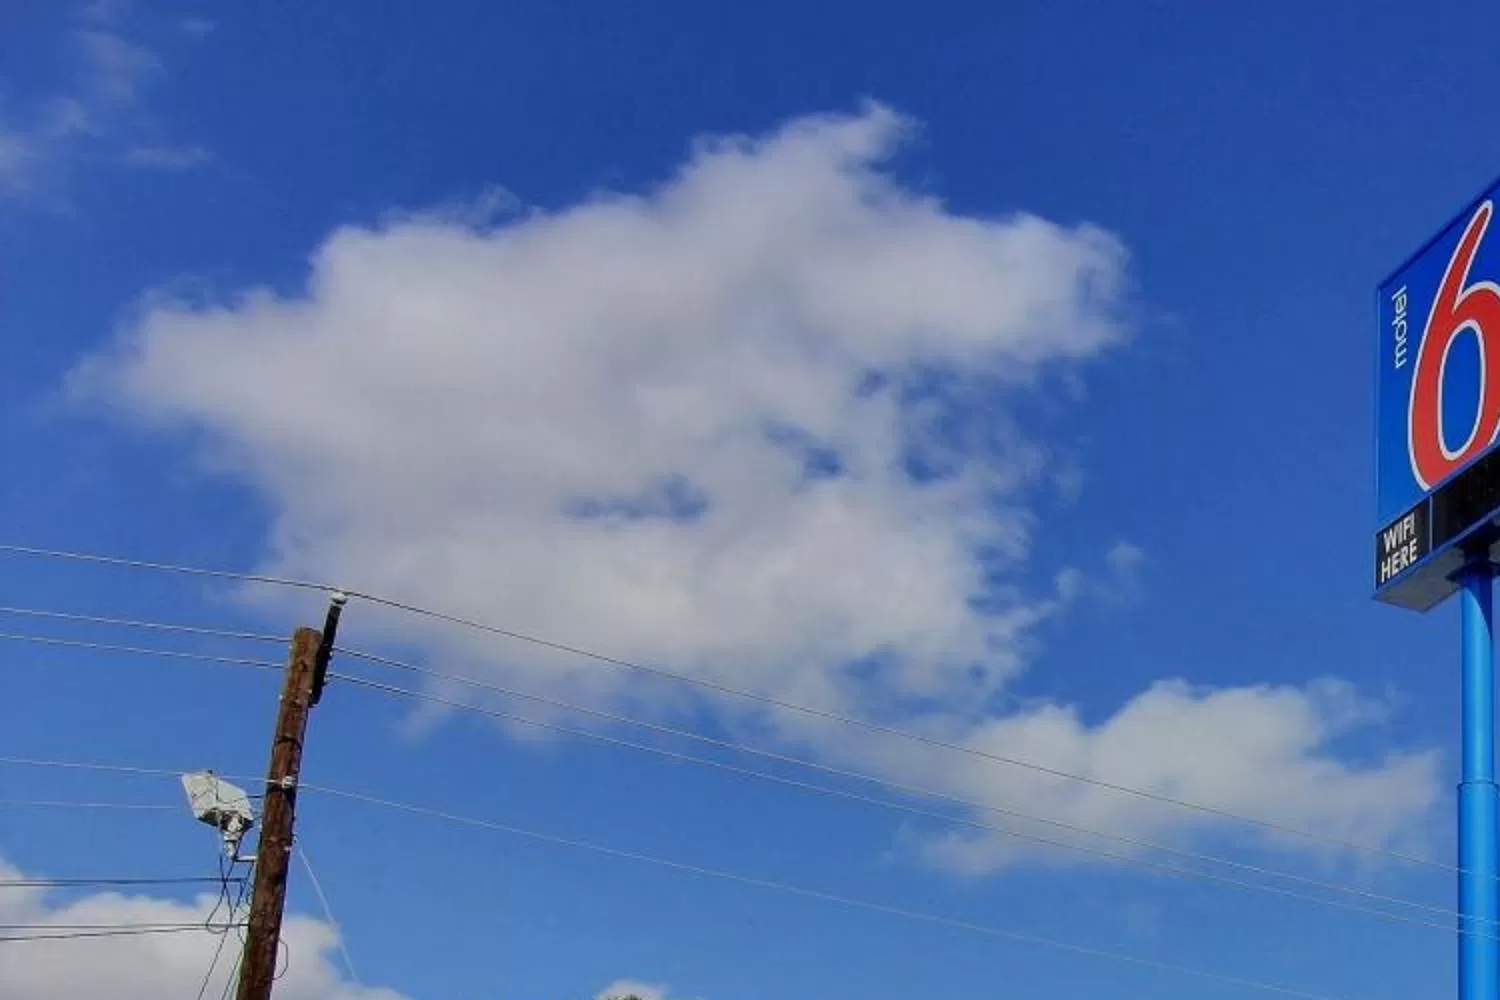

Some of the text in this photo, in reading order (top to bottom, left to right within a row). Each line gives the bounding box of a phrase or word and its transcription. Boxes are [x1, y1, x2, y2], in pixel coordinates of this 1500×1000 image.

[1392, 284, 1407, 369] motel
[1383, 511, 1415, 554] WIFI
[1381, 537, 1418, 583] HERE
